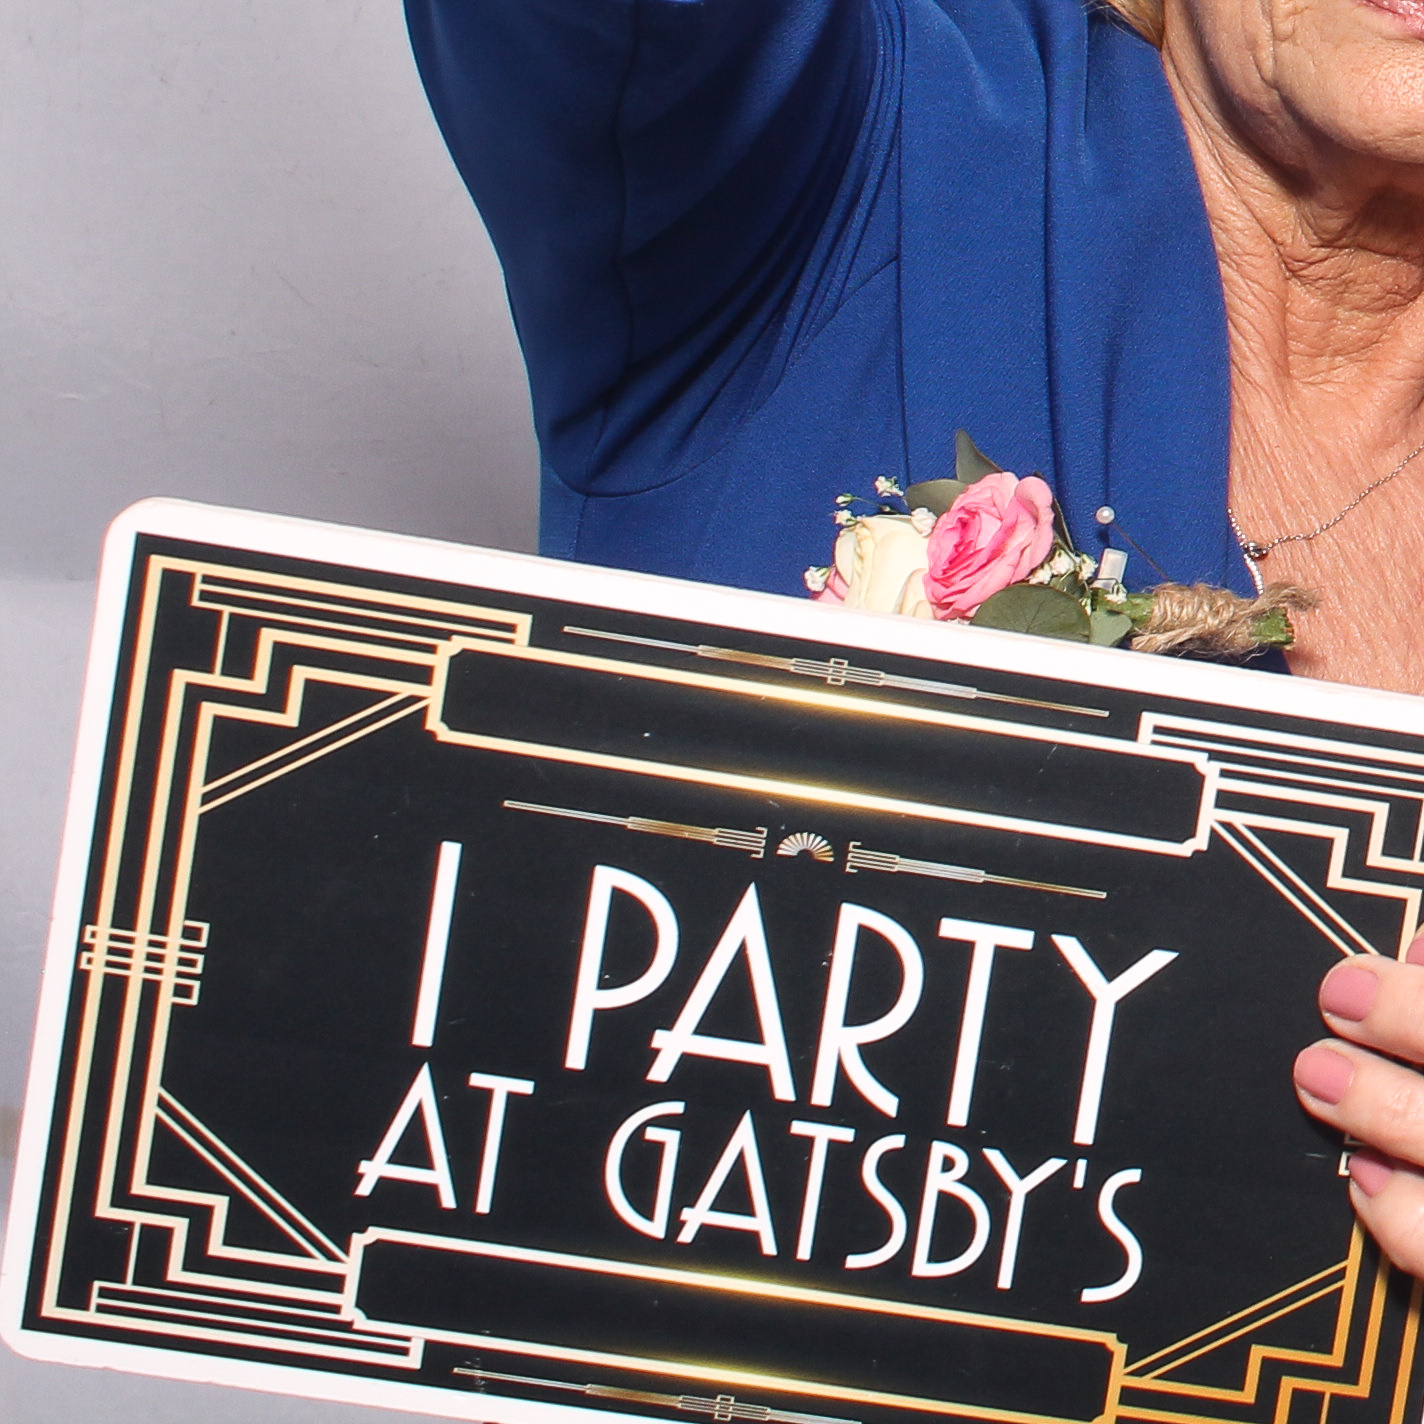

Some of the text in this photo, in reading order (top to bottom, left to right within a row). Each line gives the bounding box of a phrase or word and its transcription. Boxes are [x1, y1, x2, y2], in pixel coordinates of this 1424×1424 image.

[412, 840, 1179, 1145] I PARTY
[354, 1061, 1143, 1302] AT GATSBY'S
